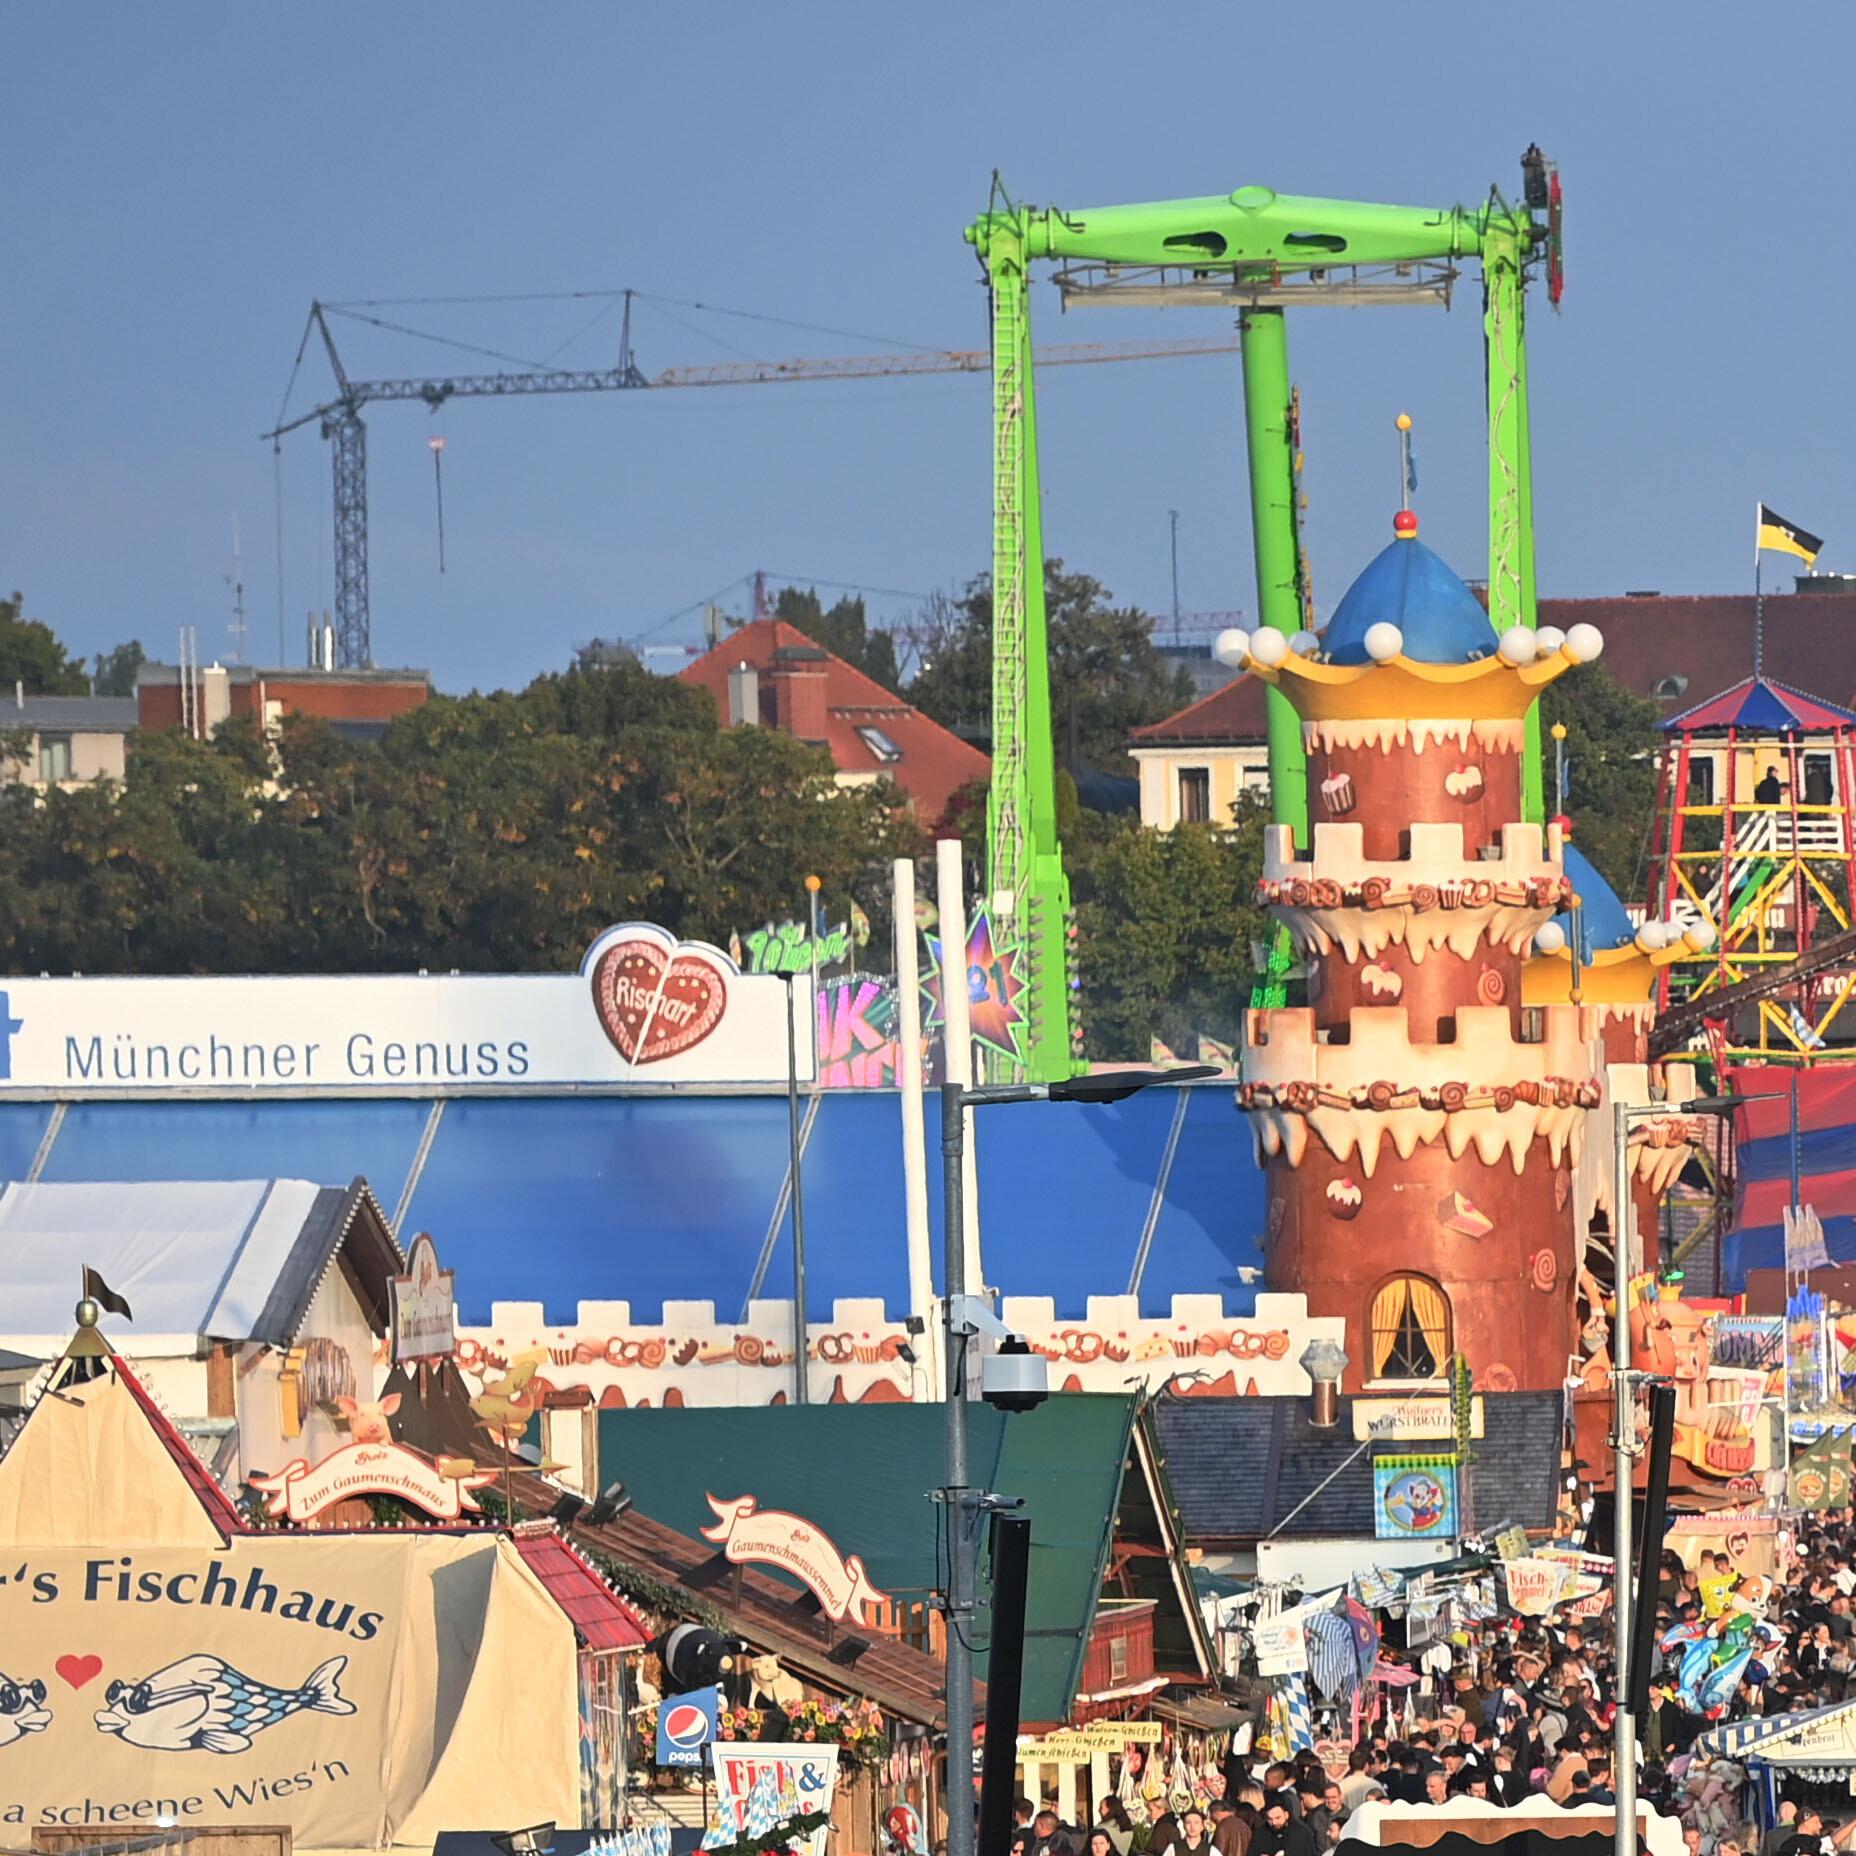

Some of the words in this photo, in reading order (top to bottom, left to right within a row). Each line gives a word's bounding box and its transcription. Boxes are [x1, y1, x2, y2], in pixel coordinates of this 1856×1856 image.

[615, 977, 697, 1026] Rischart
[64, 1034, 321, 1079] Münchner
[346, 1033, 531, 1077] Genuss
[0, 1562, 60, 1603] 's
[84, 1556, 384, 1642] Fischhaus
[668, 1752, 702, 1764] peps
[799, 1762, 826, 1792] &
[3, 1808, 25, 1825] a
[40, 1796, 203, 1826] scheene
[214, 1760, 350, 1810] Wies'n
